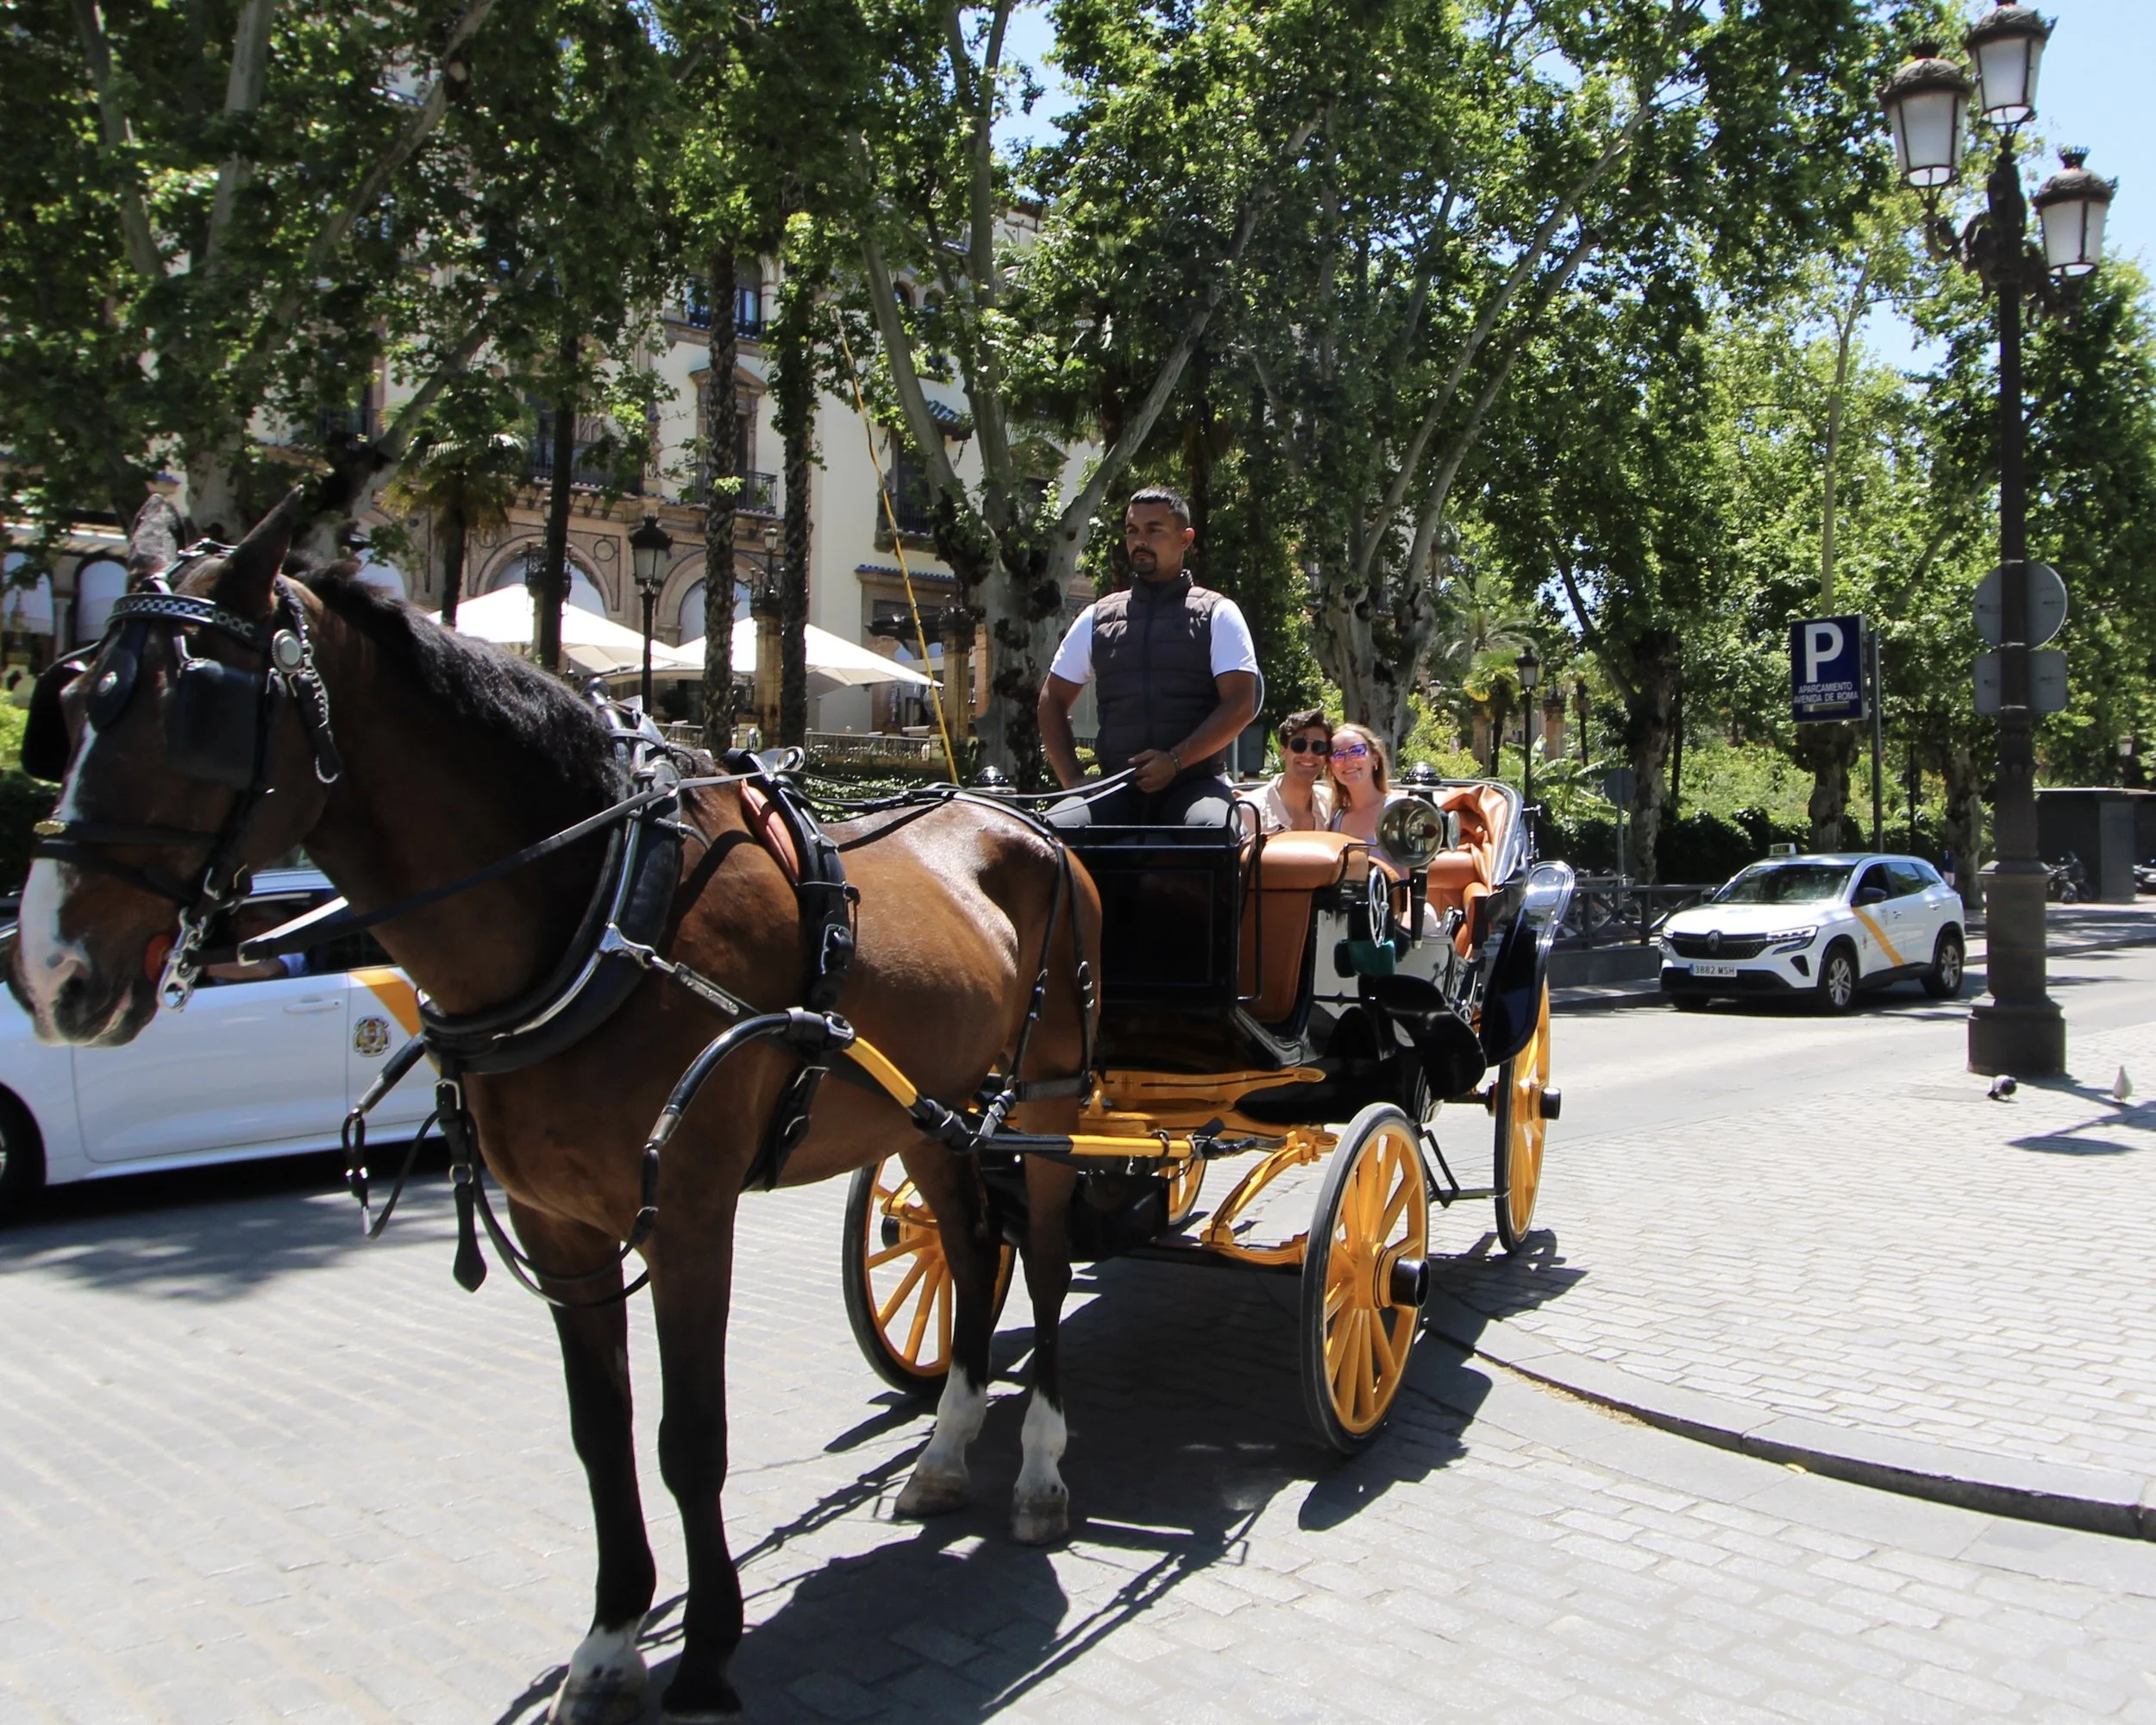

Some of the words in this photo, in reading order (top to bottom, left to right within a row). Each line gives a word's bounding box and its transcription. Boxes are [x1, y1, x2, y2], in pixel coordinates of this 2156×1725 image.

[1805, 622, 1844, 683] P
[1798, 681, 1852, 693] APARCAMIENTO
[1794, 693, 1822, 704] AVENIDA
[1824, 692, 1835, 702] DE
[1837, 691, 1858, 701] ROMA
[1695, 965, 1716, 975] 3882
